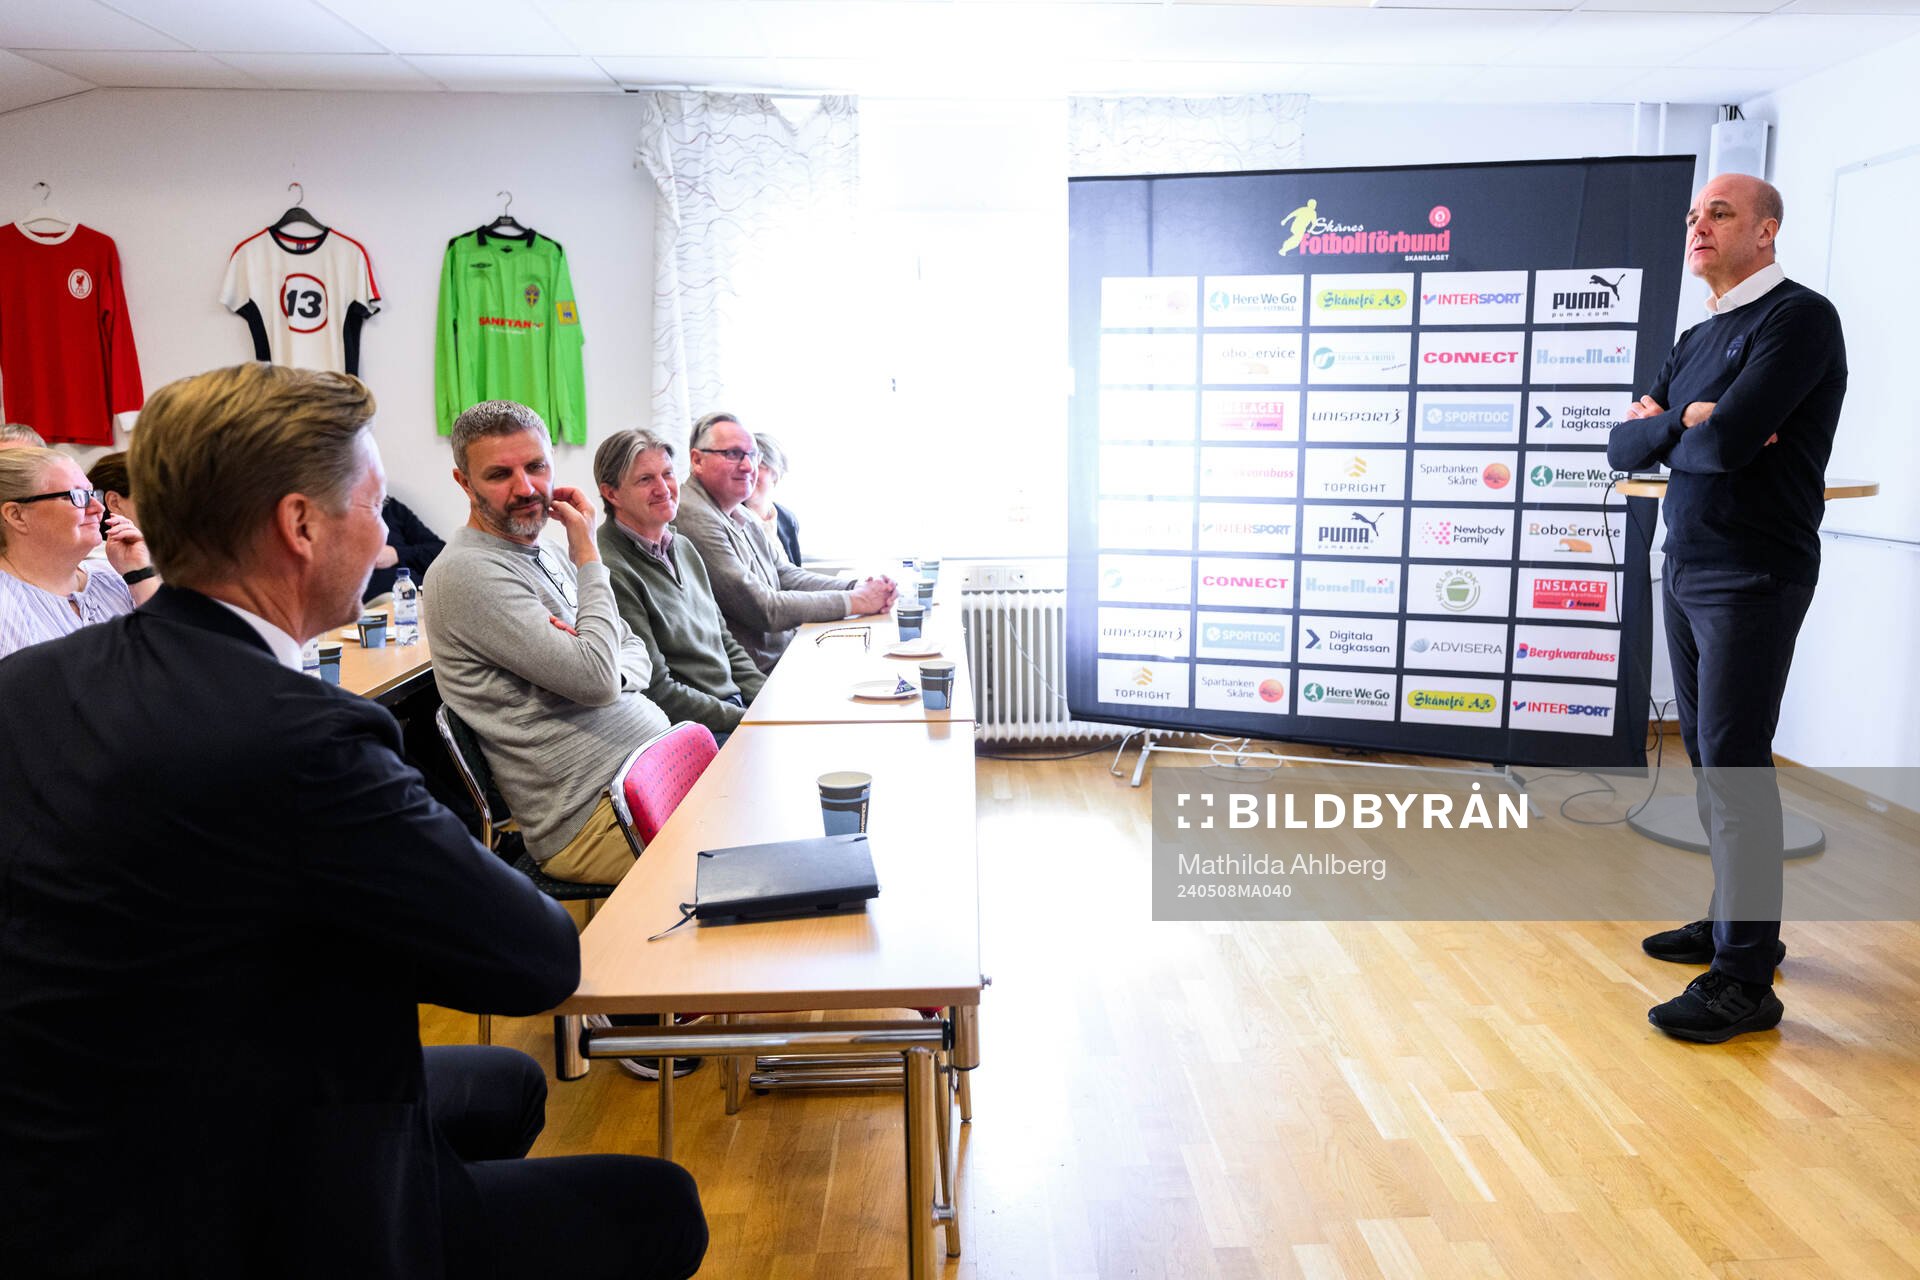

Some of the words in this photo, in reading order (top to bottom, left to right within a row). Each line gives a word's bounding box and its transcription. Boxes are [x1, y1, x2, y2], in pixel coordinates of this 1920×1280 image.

[1307, 217, 1364, 235] Skånes
[1404, 254, 1450, 262] SKÅNELAGET
[287, 289, 322, 319] 13
[1232, 293, 1259, 305] Here
[1260, 293, 1279, 304] We
[1281, 292, 1297, 304] Go
[1438, 293, 1521, 305] INTERSPORT
[1552, 291, 1610, 310] PUMA
[1423, 351, 1519, 364] CONNECT
[1536, 347, 1631, 364] HomeMaid
[1444, 410, 1509, 424] SPORTDOC
[1562, 406, 1611, 419] Digitala
[1561, 419, 1624, 432] Lagkassa
[1420, 463, 1478, 474] Sparbanken
[1555, 468, 1585, 480] Here
[1586, 469, 1607, 481] We
[1609, 470, 1625, 481] Go
[1323, 482, 1387, 493] TOPRIGHT
[1447, 475, 1478, 487] Skåne
[1215, 523, 1292, 535] INTERSPORT
[1318, 526, 1370, 543] PUMA
[1453, 524, 1506, 536] Newbody
[1529, 523, 1621, 538] RoboService
[1453, 535, 1490, 545] Family
[1202, 575, 1289, 589] CONNECT
[1305, 577, 1395, 594] HomeMaid
[1535, 580, 1606, 593] INSLAGET
[1222, 629, 1281, 643] SPORTDOC
[1329, 630, 1373, 642] Digitala
[1329, 642, 1390, 654] Lagkassan
[1430, 641, 1503, 655] ADVISERA
[1529, 647, 1616, 662] Bergkvarabuss
[1201, 677, 1255, 688] Sparbanken
[1115, 688, 1171, 700] TOPRIGHT
[1226, 688, 1255, 698] Skåne
[1326, 686, 1353, 698] Here
[1354, 687, 1372, 699] We
[1374, 689, 1390, 700] Go
[1528, 702, 1611, 718] INTERSPORT
